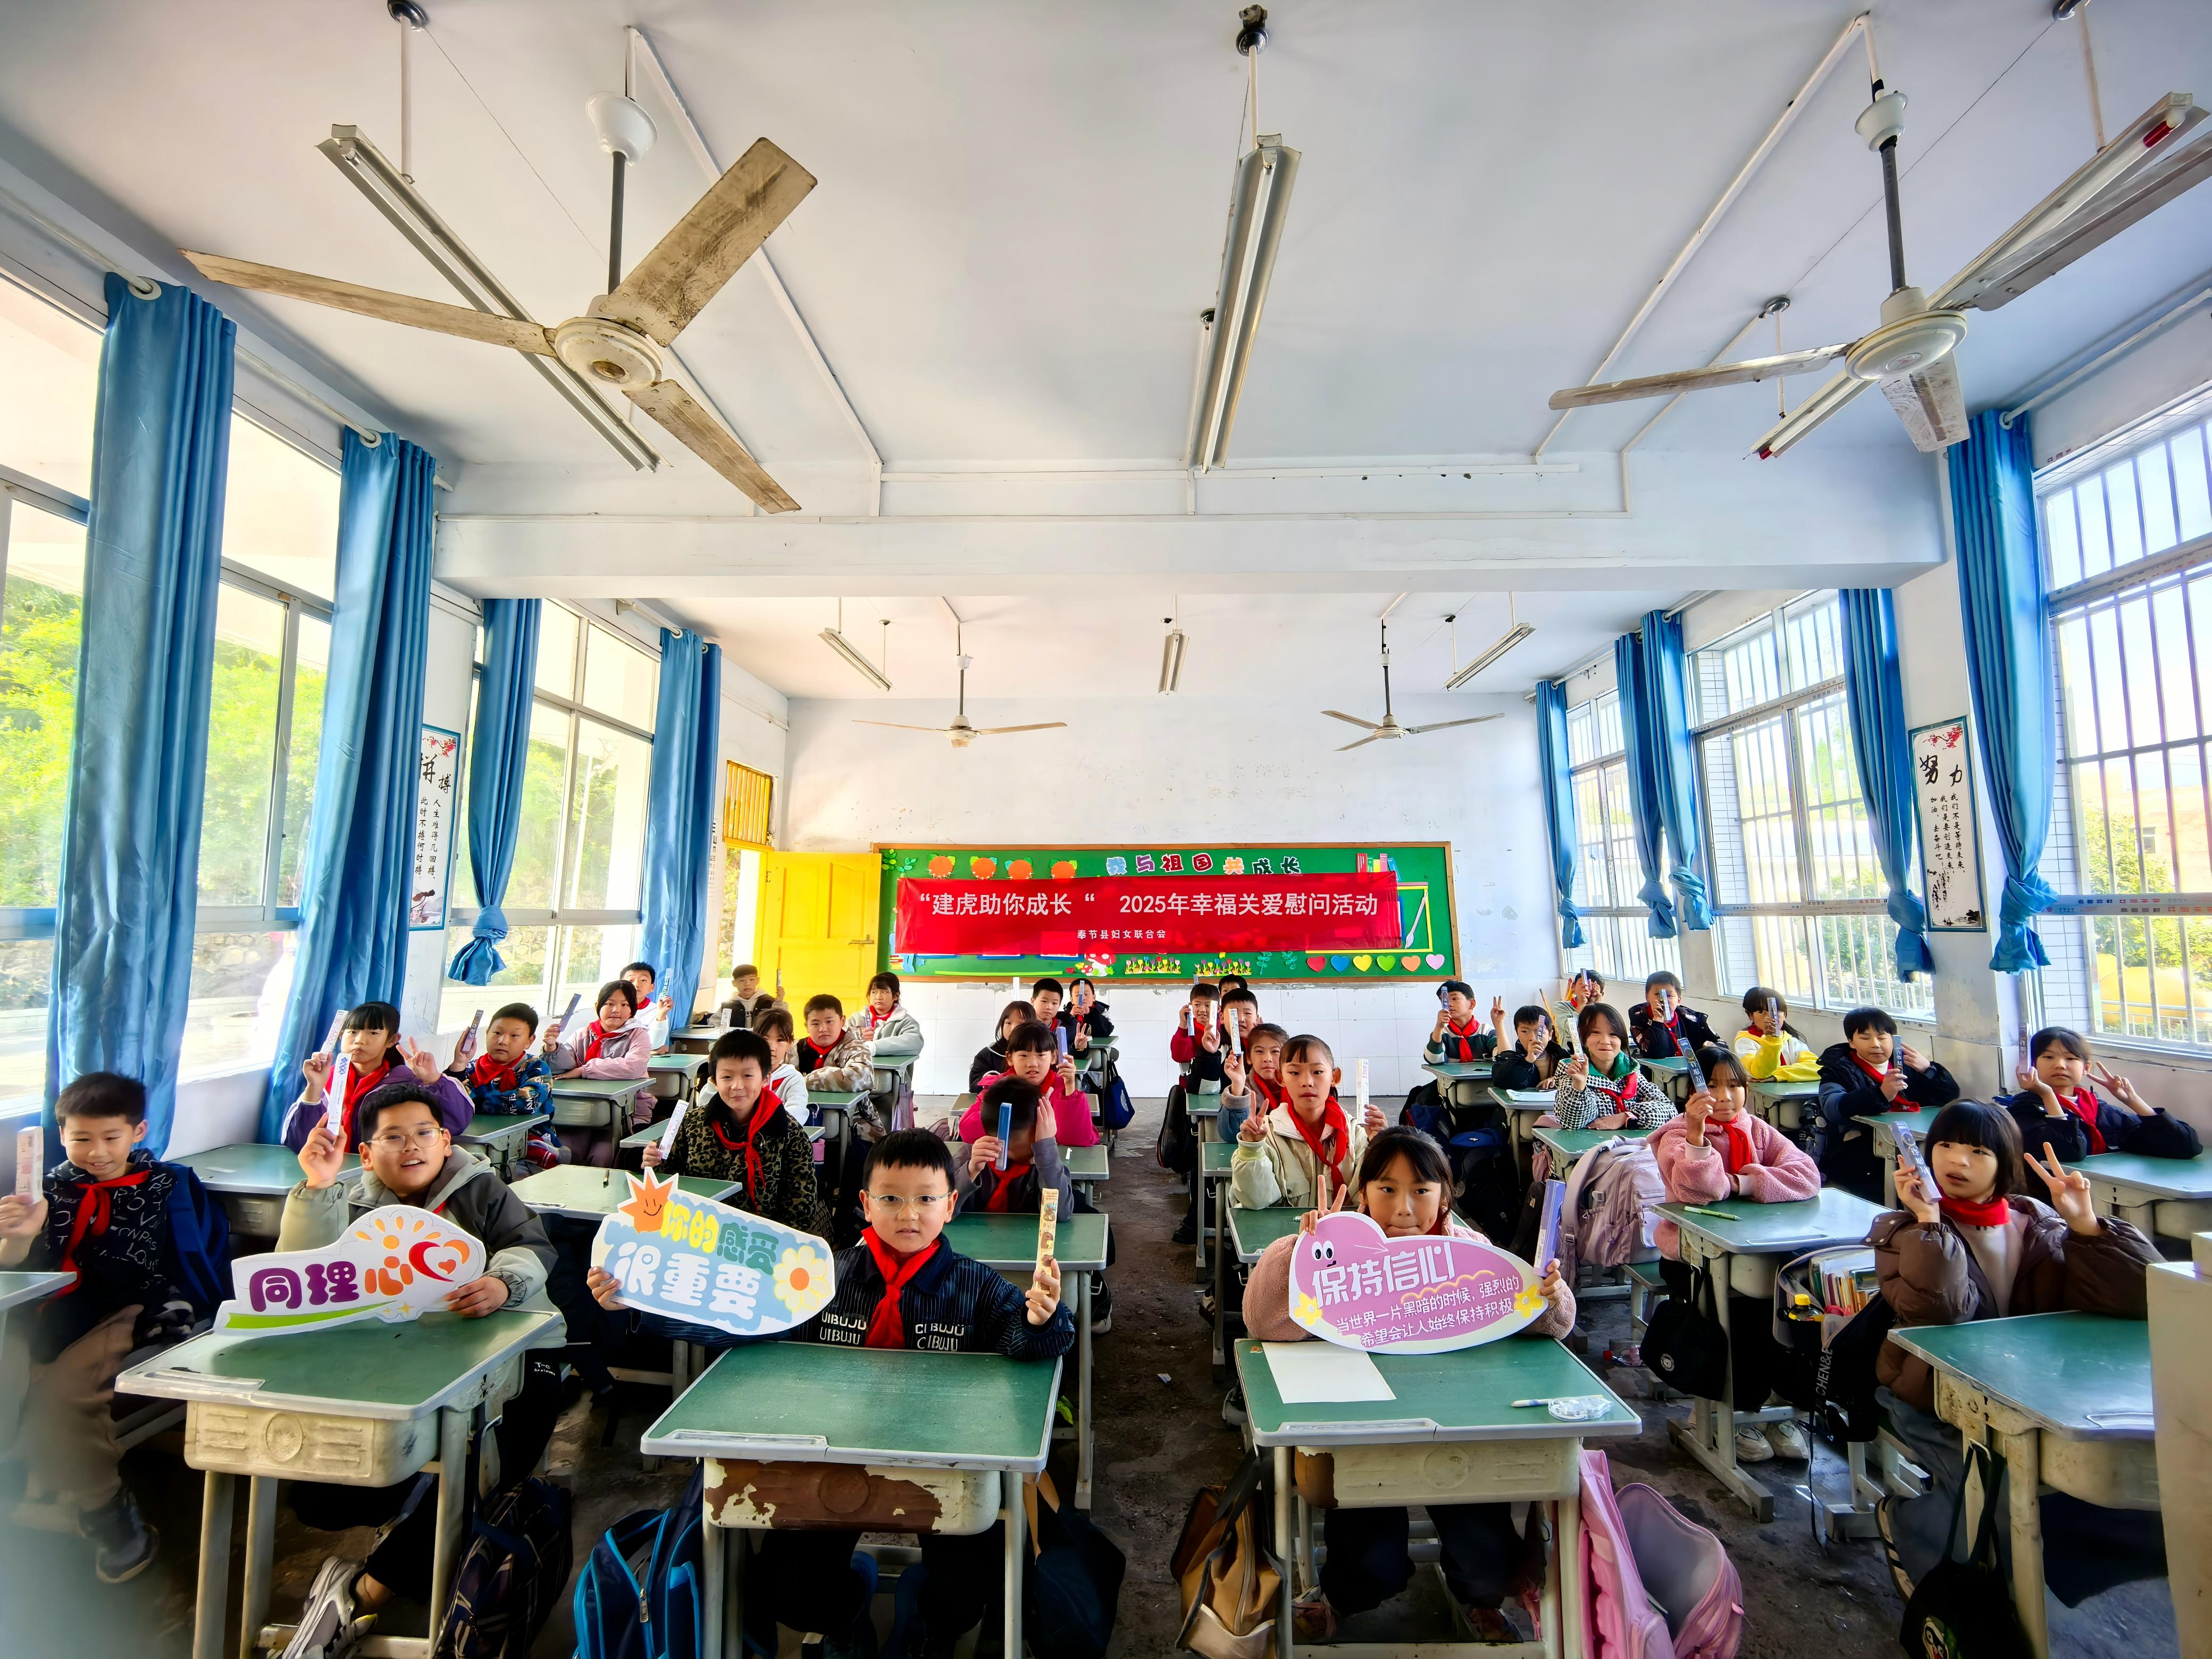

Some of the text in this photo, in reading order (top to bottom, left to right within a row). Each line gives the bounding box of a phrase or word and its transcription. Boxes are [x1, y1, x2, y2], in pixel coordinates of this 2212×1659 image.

[1920, 755, 1962, 787] 努力
[1119, 893, 1378, 916] 2025年幸福关爱慰问活动
[1077, 929, 1166, 940] 奉节县妇女联合会
[660, 1201, 779, 1275] 你的感受
[249, 1255, 414, 1312] 同理心
[614, 1242, 761, 1320] 很重要
[1311, 1241, 1456, 1309] 保持信心
[1360, 1297, 1514, 1347] 希望会让人始终保持积极
